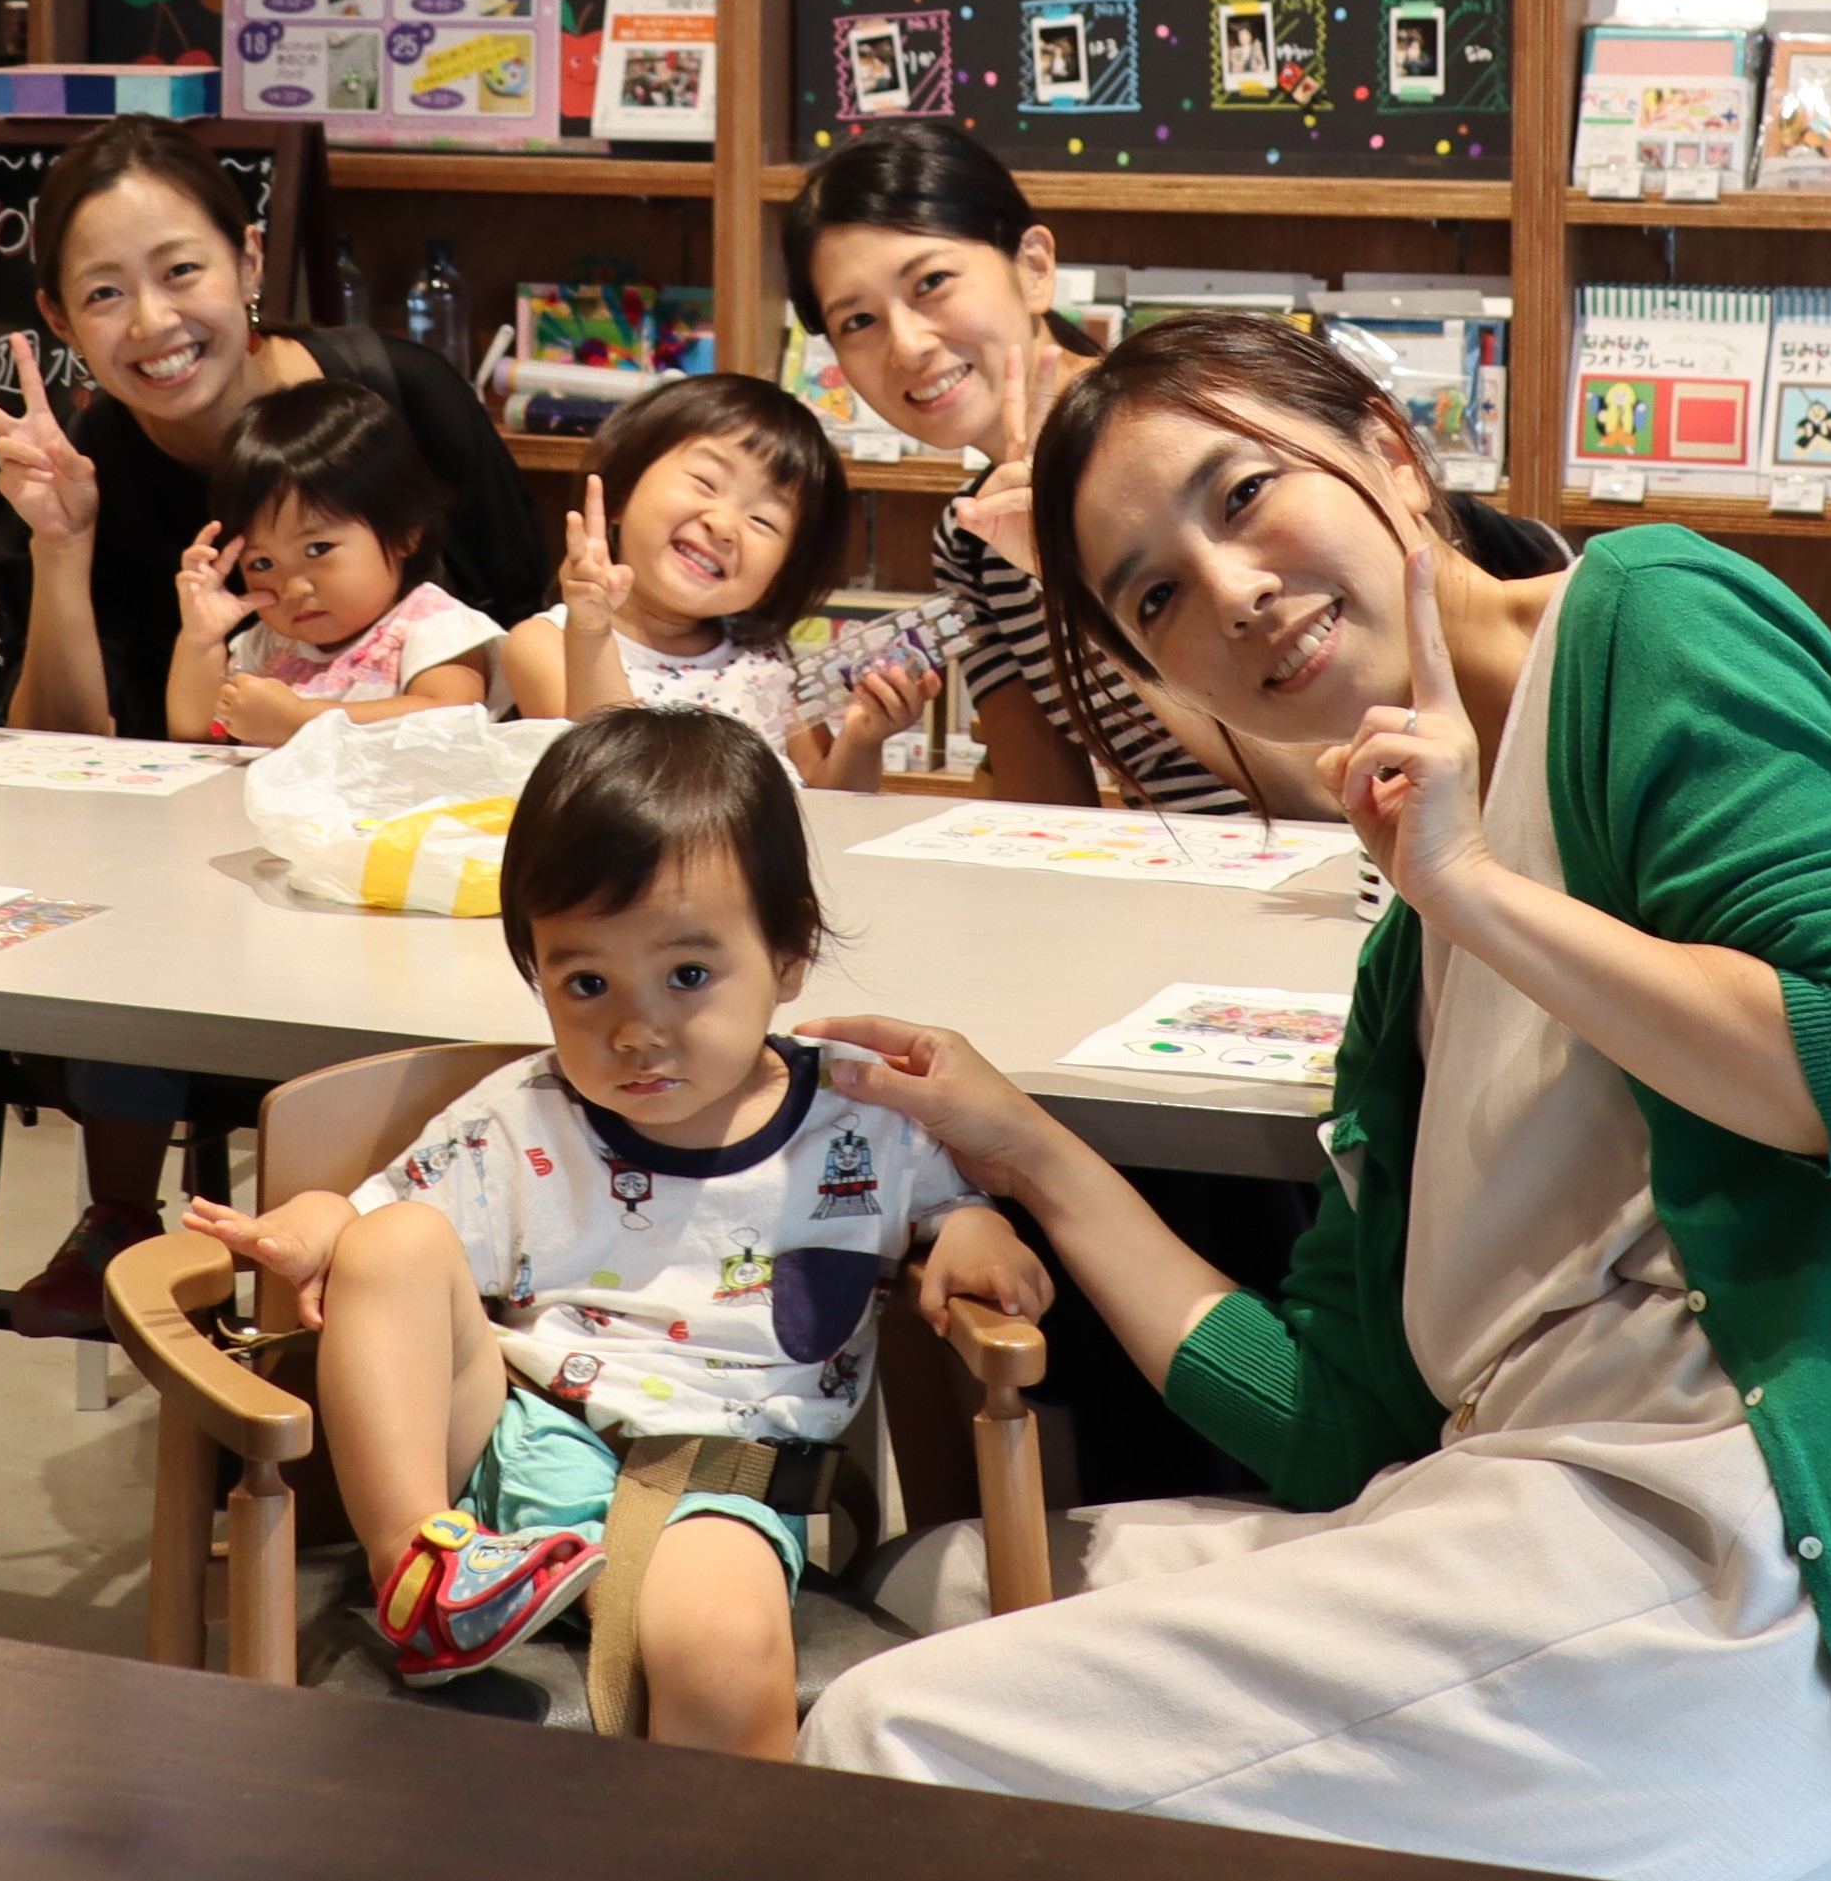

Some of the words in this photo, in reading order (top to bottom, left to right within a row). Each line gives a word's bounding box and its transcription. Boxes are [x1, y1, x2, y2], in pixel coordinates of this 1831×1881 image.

[1582, 334, 1650, 351] なみなみ
[1582, 352, 1695, 370] フォトフレーム
